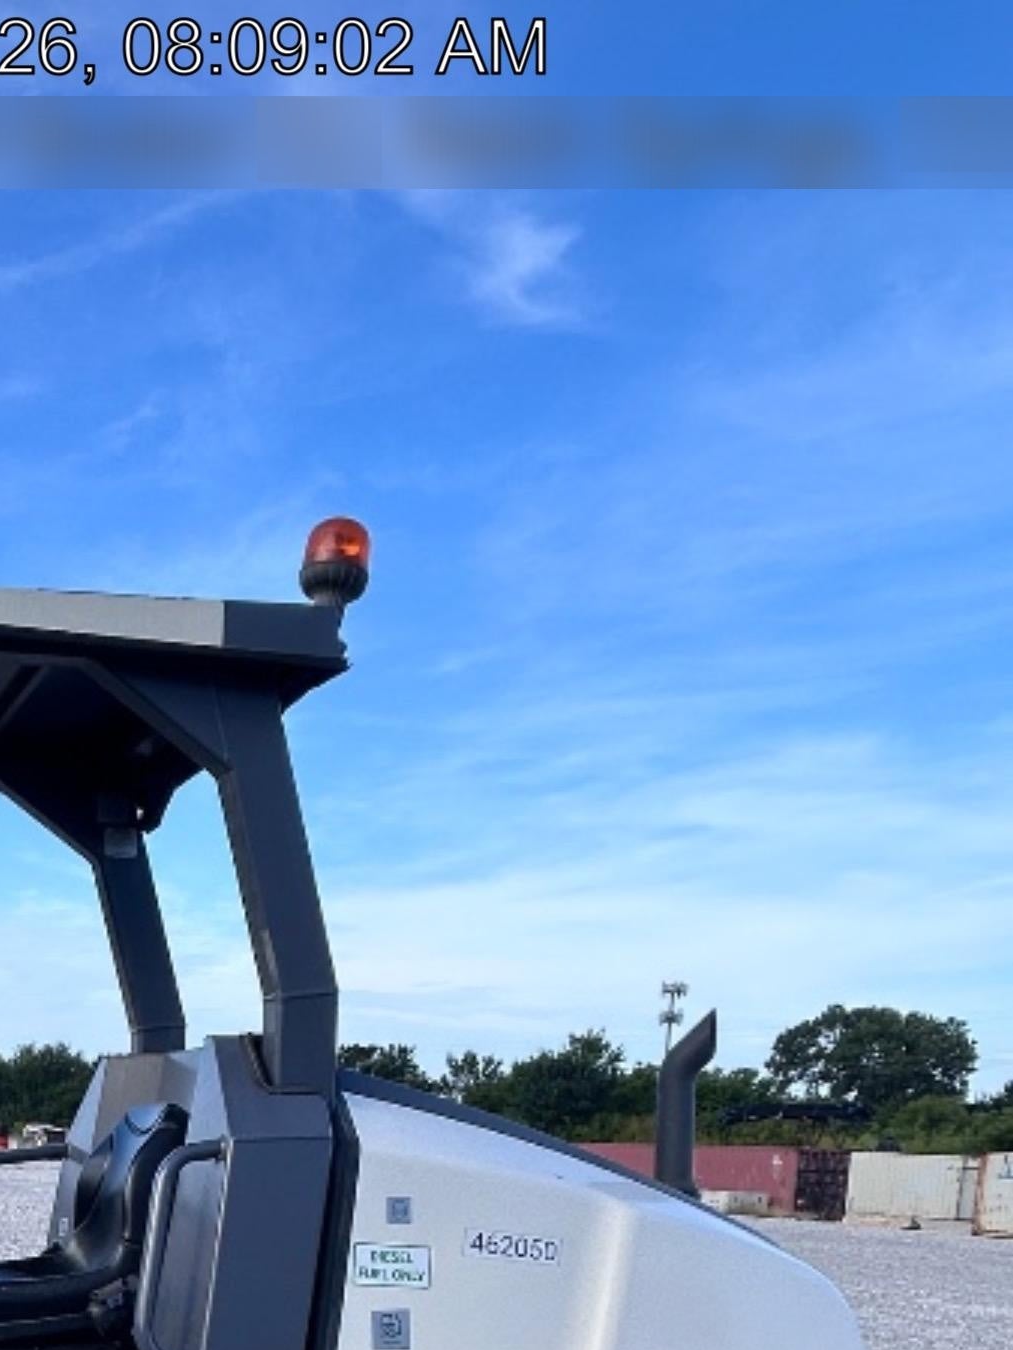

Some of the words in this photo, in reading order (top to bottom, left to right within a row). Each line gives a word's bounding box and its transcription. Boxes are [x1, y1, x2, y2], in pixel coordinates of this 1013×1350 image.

[370, 1250, 413, 1263] DIESEL
[359, 1266, 388, 1280] FUEL
[391, 1268, 425, 1282] ONLY
